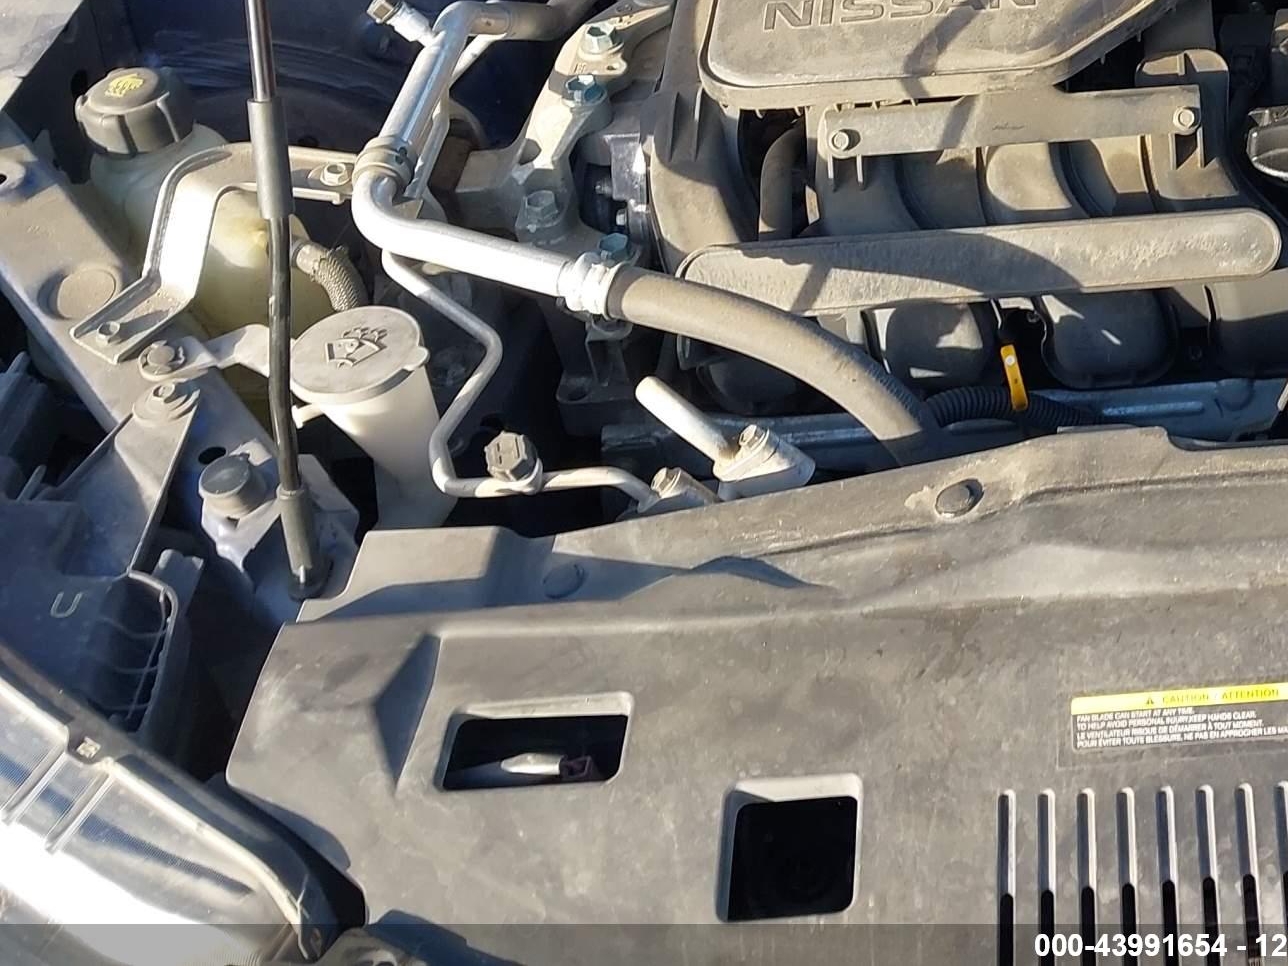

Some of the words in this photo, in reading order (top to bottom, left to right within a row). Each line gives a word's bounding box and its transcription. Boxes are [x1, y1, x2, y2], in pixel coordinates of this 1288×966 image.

[1162, 693, 1209, 704] CAUTION
[1222, 688, 1279, 699] ATTENTION
[1077, 722, 1087, 731] TO
[1088, 721, 1106, 730] HELP
[1106, 720, 1127, 729] AVOID
